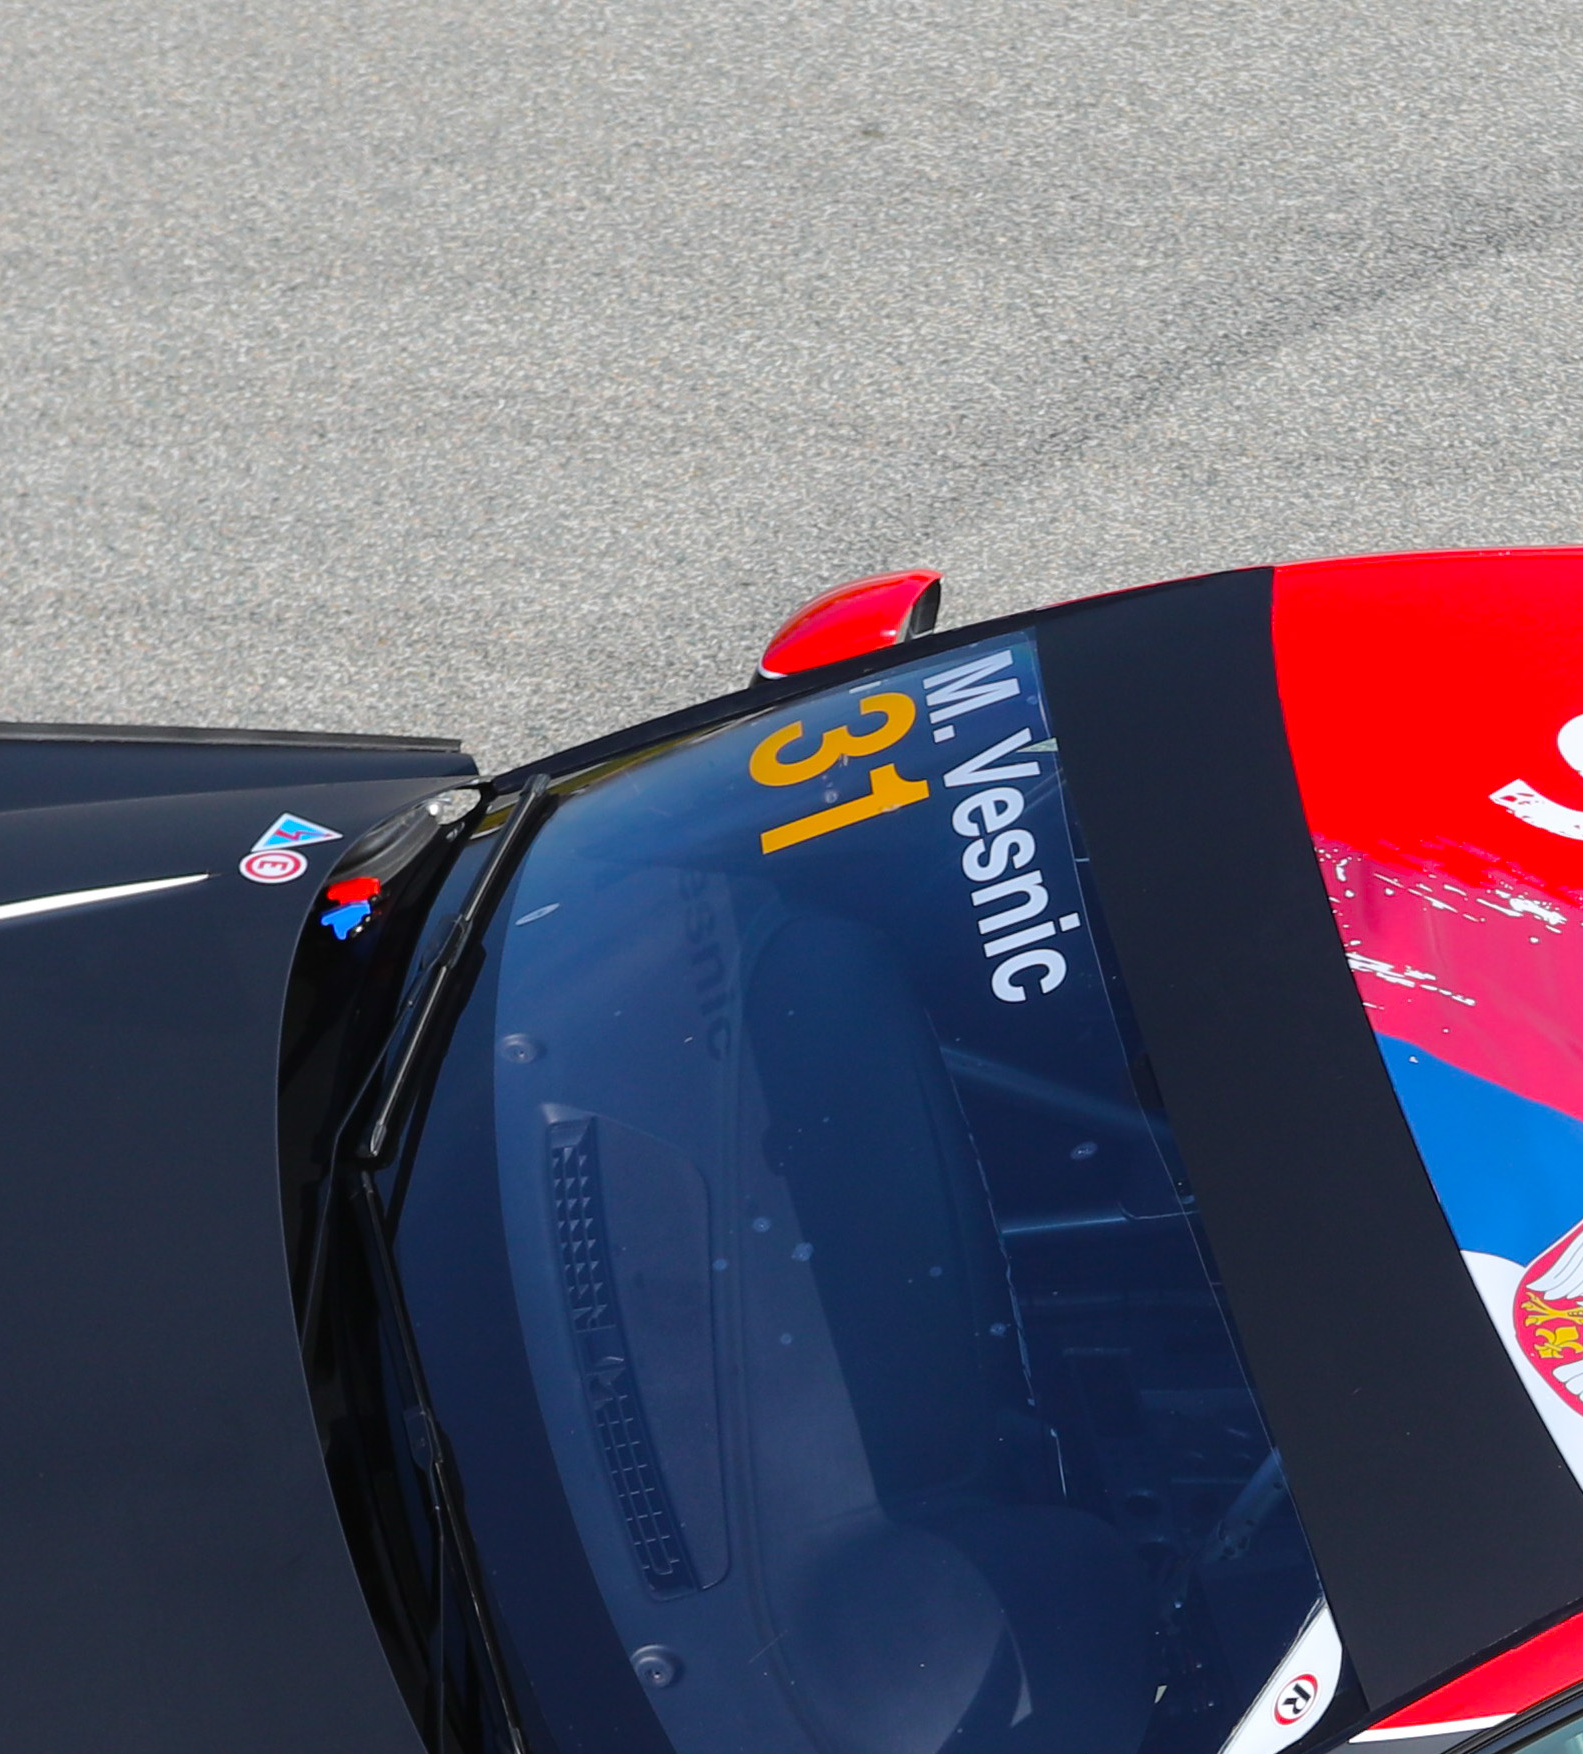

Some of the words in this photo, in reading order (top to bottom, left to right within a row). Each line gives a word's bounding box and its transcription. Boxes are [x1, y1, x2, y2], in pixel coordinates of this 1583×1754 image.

[749, 692, 932, 855] 31
[922, 648, 1021, 744] M.
[943, 731, 1081, 1003] Vesnic
